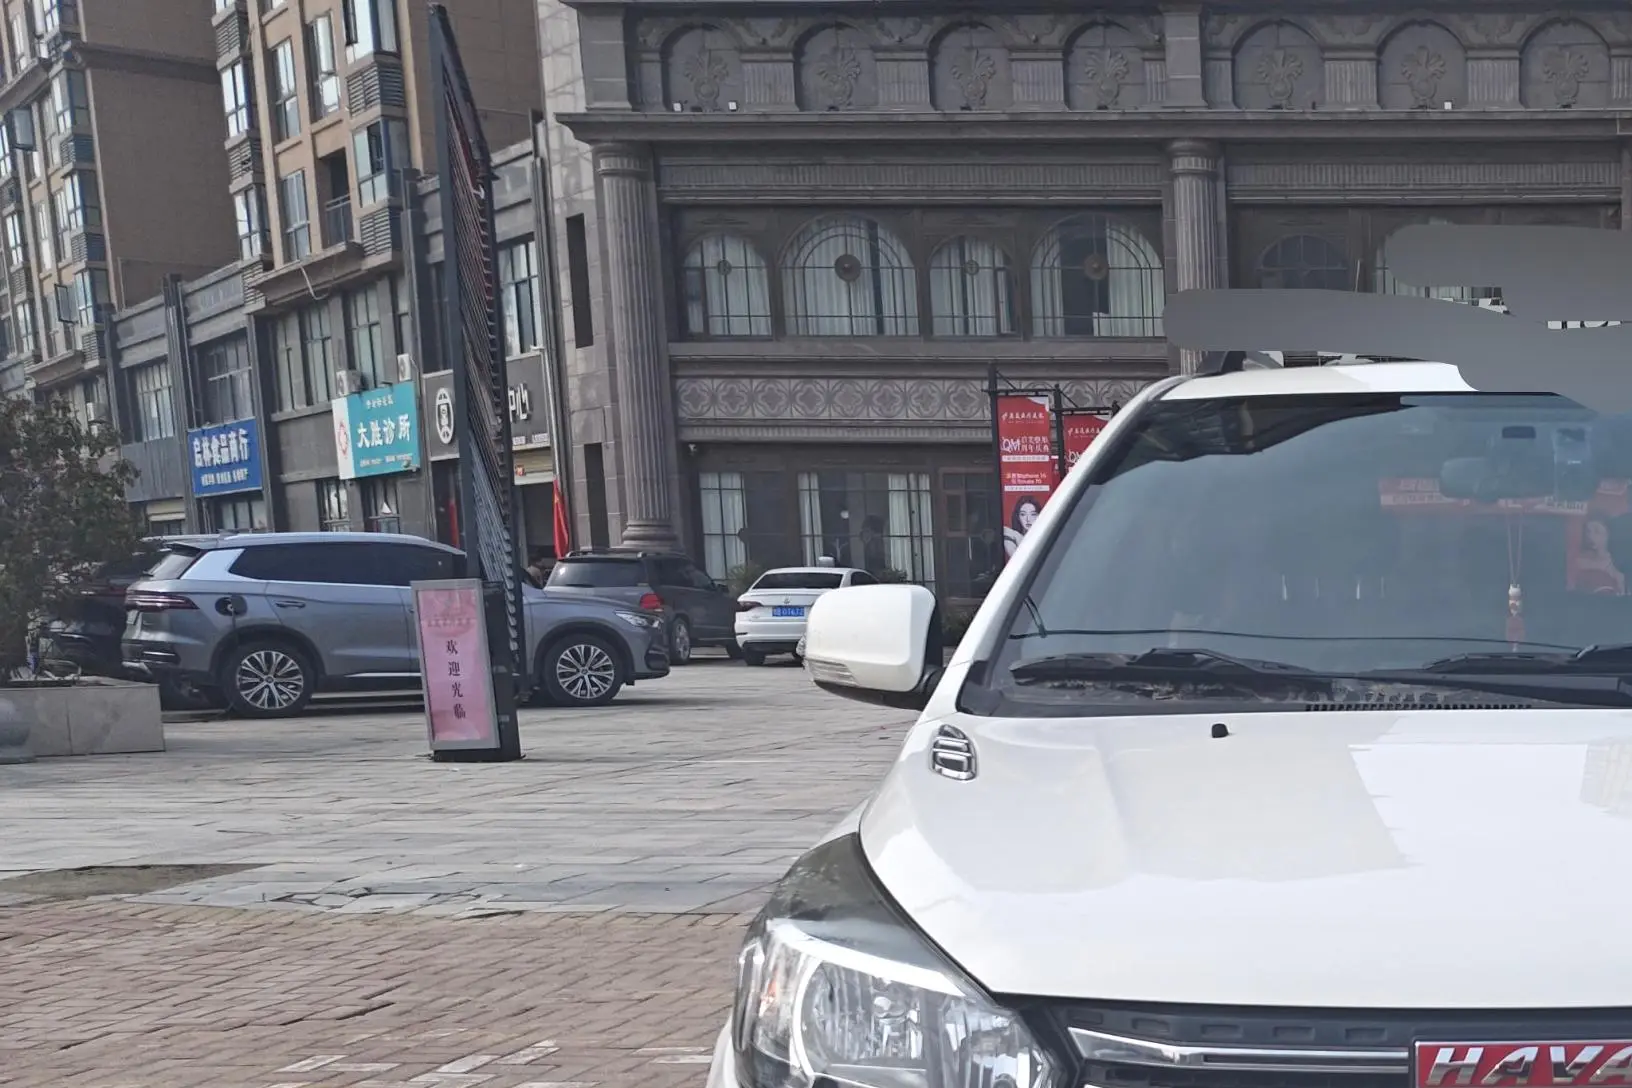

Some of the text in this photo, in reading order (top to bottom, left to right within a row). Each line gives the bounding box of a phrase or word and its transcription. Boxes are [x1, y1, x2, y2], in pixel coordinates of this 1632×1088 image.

[357, 413, 411, 448] 大胜诊所
[446, 639, 466, 719] 欢迎光临
